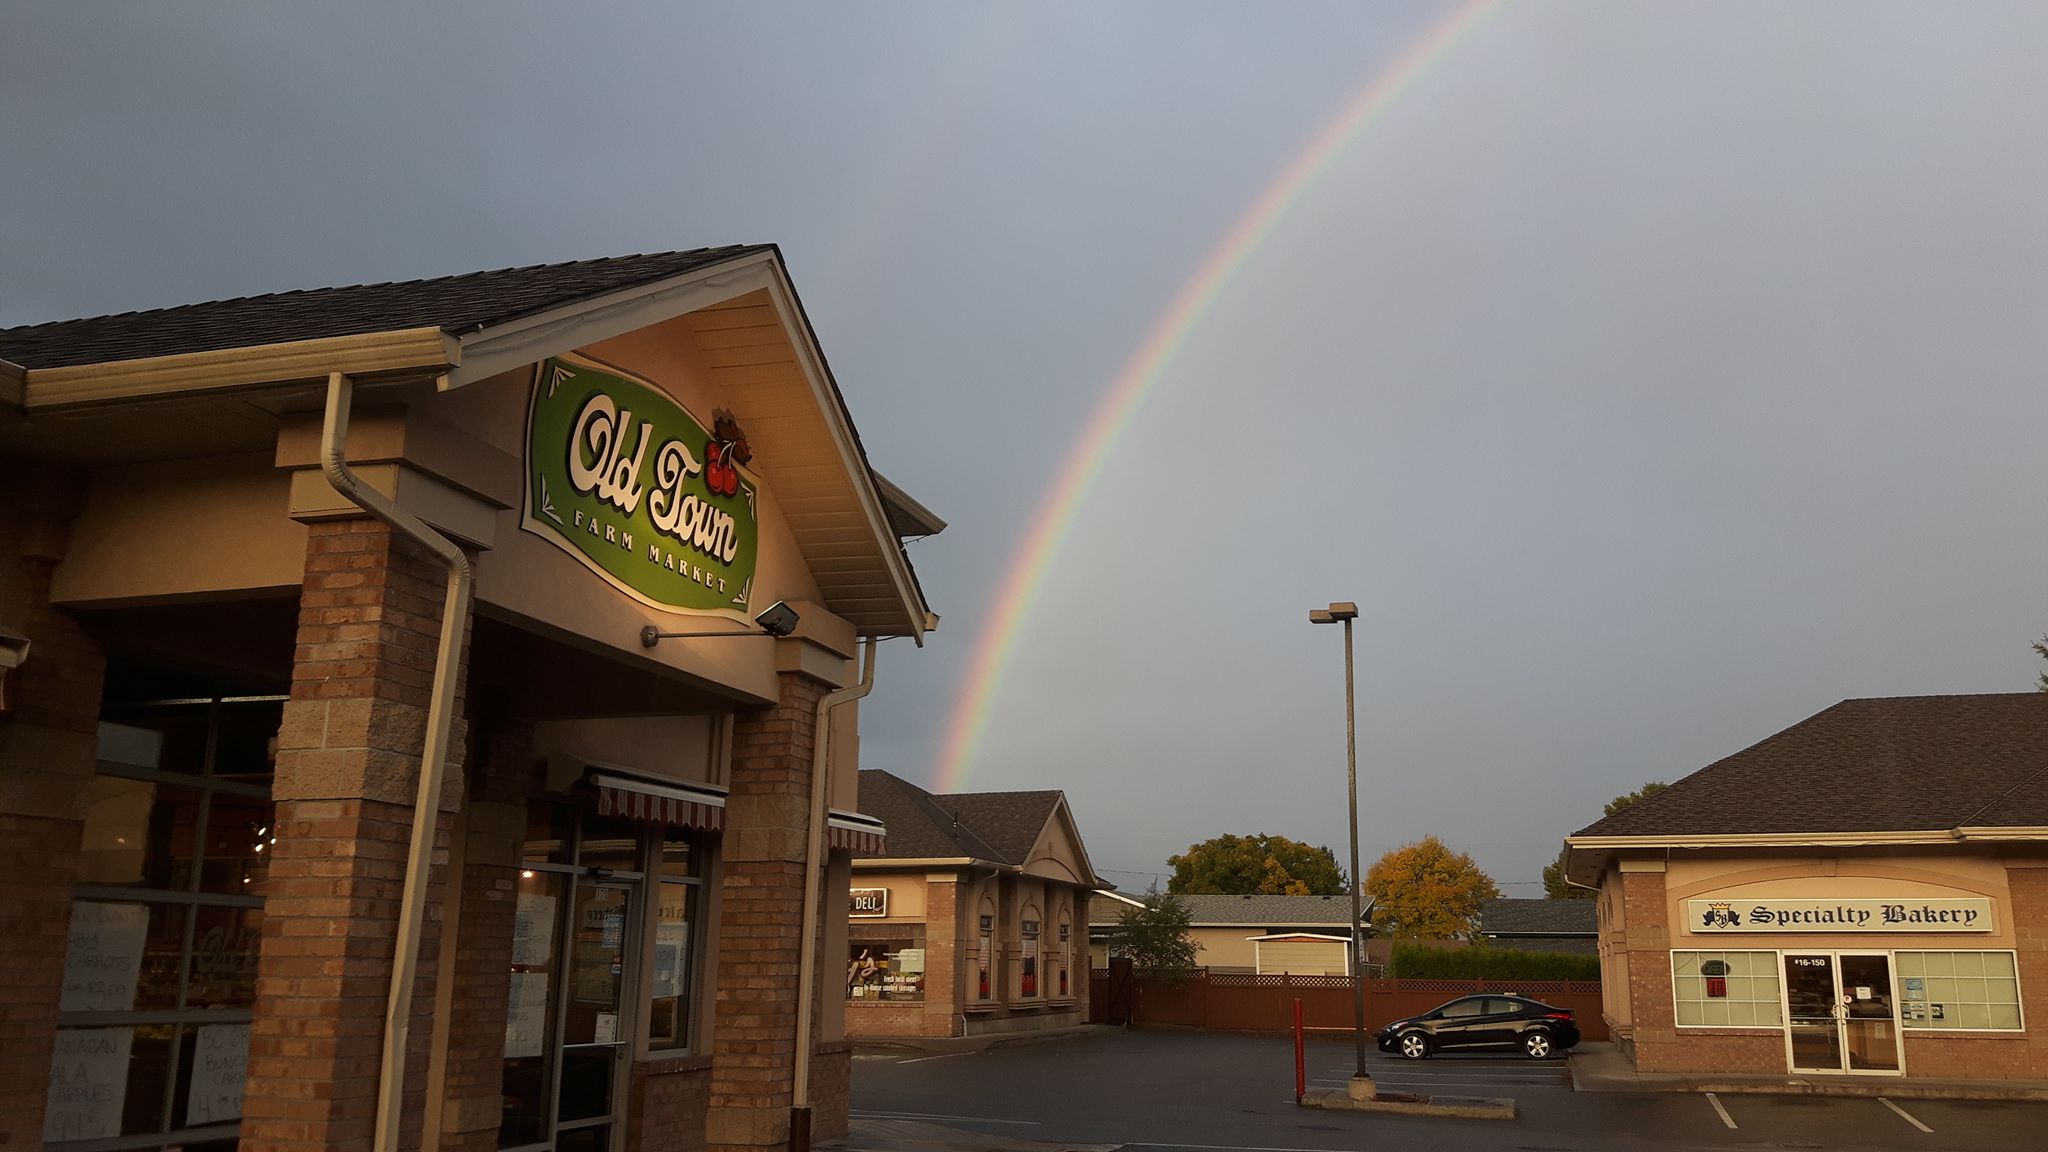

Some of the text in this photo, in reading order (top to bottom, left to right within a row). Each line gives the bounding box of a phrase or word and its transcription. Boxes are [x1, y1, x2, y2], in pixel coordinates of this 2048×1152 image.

[570, 394, 738, 563] Old Town
[574, 509, 726, 594] FARM MARKET
[855, 896, 877, 910] DELI
[1749, 904, 1978, 927] Specialty Bakery
[1794, 958, 1826, 967] #16-150
